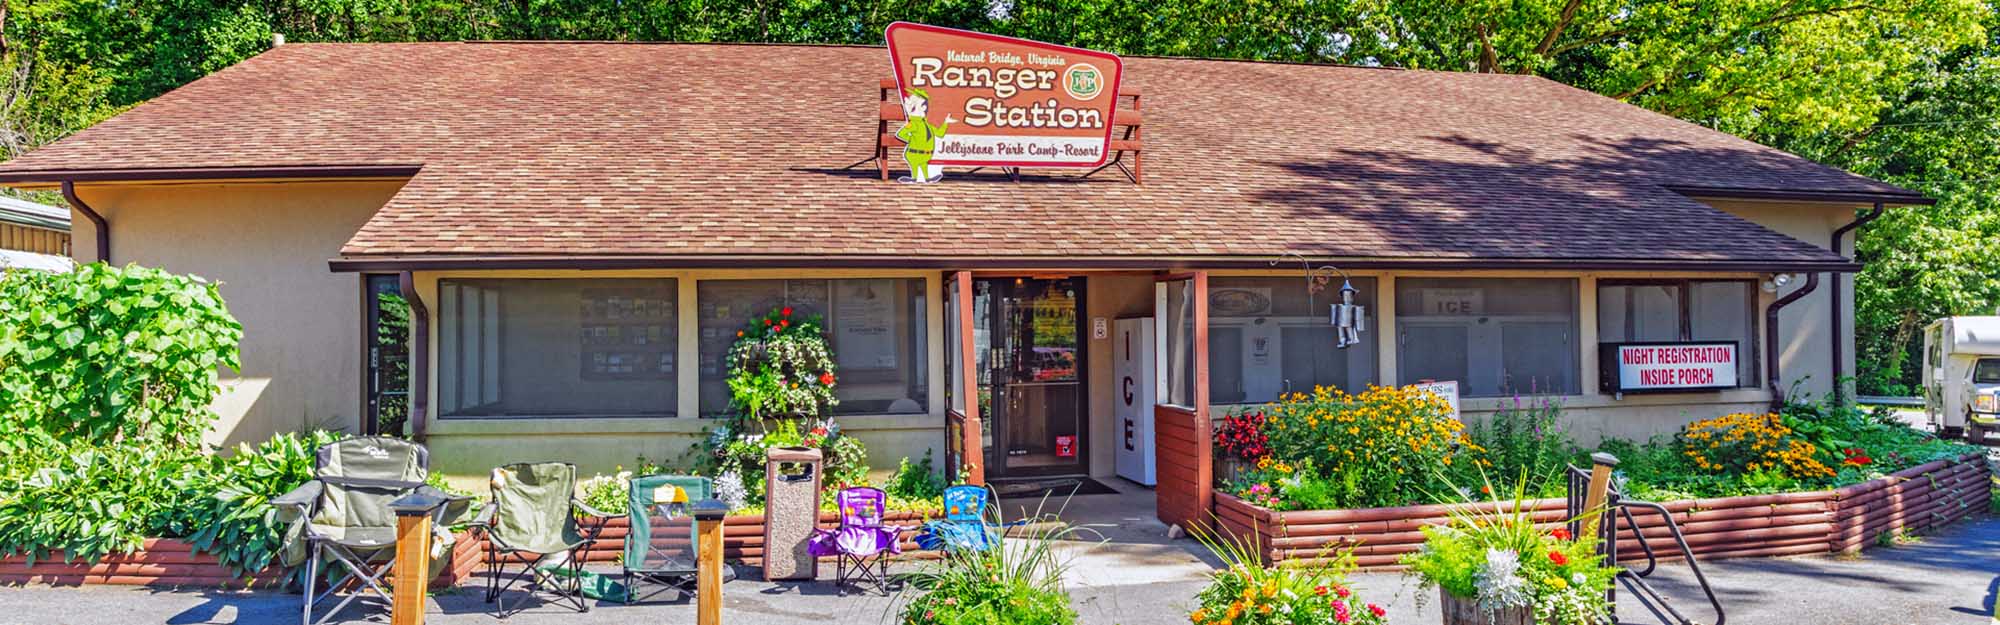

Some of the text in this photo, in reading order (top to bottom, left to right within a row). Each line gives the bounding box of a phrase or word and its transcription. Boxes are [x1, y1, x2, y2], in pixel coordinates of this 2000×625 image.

[947, 50, 1065, 67] Natural Bridge, Virginia
[912, 57, 1056, 98] Ranger
[965, 97, 1103, 129] Station
[938, 142, 1099, 157] Jellystone Park Camp-Resort
[1437, 301, 1472, 313] ICE
[1623, 347, 1730, 365] NIGHT REGISTRATION
[1641, 368, 1713, 385] INSIDE PORCH
[1123, 331, 1134, 451] ICE
